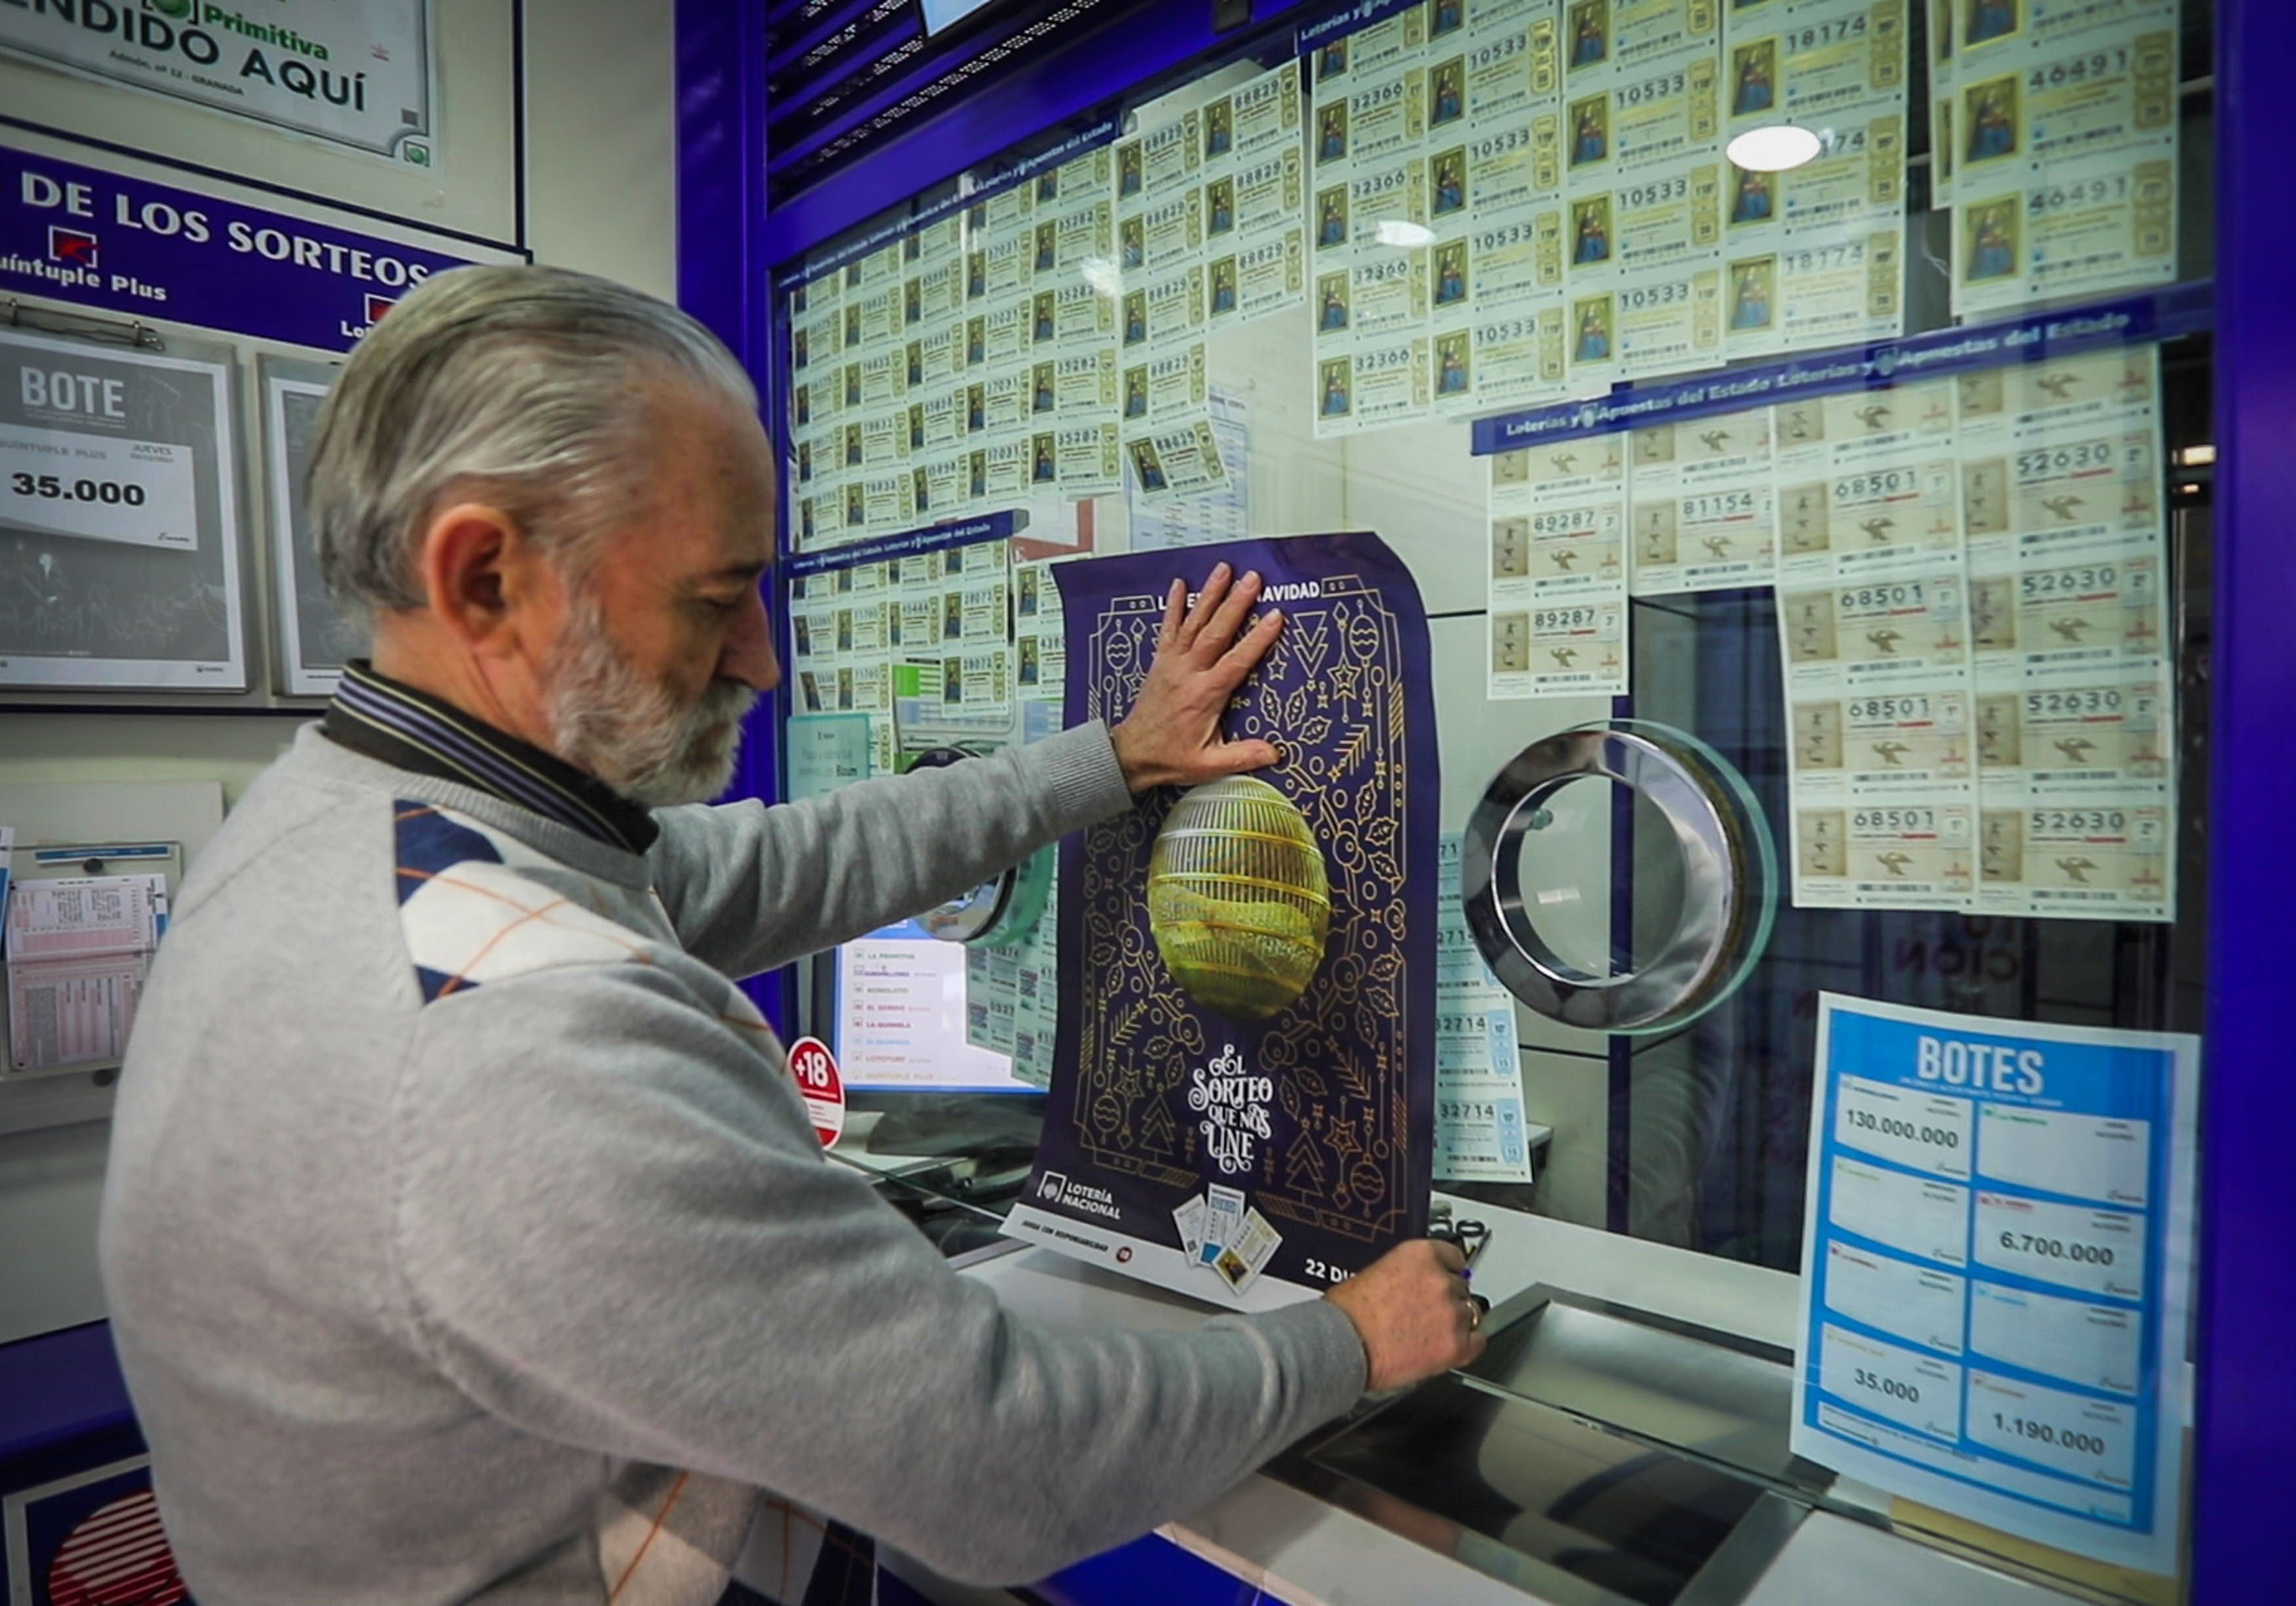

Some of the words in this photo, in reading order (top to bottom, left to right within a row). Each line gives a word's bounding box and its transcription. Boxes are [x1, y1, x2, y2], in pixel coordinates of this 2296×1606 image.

[204, 4, 329, 61] Primitiva
[1787, 15, 1866, 53] 18174
[0, 0, 219, 64] NDIDO
[240, 48, 365, 112] AQUÍ
[1471, 34, 1527, 70] 10533
[2029, 50, 2128, 89] 46491
[1616, 74, 1685, 108] 10533
[1473, 131, 1530, 160] 10533
[1620, 179, 1687, 209] 10533
[2028, 176, 2128, 213] 46491
[21, 171, 94, 218] DE
[116, 194, 209, 243] LOS
[228, 221, 431, 290] SORTEOS
[1475, 224, 1532, 253] 10533
[1786, 244, 1863, 272] 18174
[111, 274, 167, 301] Plus
[1621, 283, 1689, 312] 10533
[1477, 319, 1536, 344] 10533
[1507, 414, 1567, 436] Loterías
[1597, 395, 1673, 422] Apuestas
[1677, 388, 1704, 405] del
[1708, 377, 1771, 400] Estado
[1778, 362, 1855, 388] Loterías
[1896, 336, 1998, 368] Apuestas
[2005, 327, 2040, 348] del
[2046, 312, 2130, 339] Estado
[20, 365, 125, 418] BOTE
[2018, 444, 2110, 476] 52630
[12, 472, 146, 506] 35.000
[1836, 470, 1916, 497] 68501
[1684, 493, 1753, 515] 81154
[1534, 510, 1595, 531] 89287
[1841, 585, 1923, 608] 68501
[2022, 569, 2116, 594] 52630
[1534, 609, 1595, 628] 89287
[1849, 698, 1930, 717] 68501
[2027, 690, 2121, 711] 52630
[1853, 810, 1934, 827] 68501
[2032, 812, 2125, 830] 52630
[794, 1050, 829, 1088] +18
[1208, 1043, 1246, 1077] EL
[1917, 1035, 2045, 1096] BOTES
[1188, 1068, 1274, 1111] SORTEO
[1208, 1104, 1237, 1128] QUE
[1239, 1103, 1272, 1140] NOS
[1441, 1104, 1494, 1118] 32714
[1846, 1107, 1959, 1149] 130.000.000
[1199, 1120, 1255, 1174] UNE
[1061, 1194, 1121, 1220] NACIONAL
[1067, 1182, 1113, 1204] LOTERÍA
[2000, 1231, 2115, 1266] 6.700.000
[1304, 1258, 1326, 1279] 22
[1854, 1367, 1920, 1404] 35.000
[1992, 1412, 2105, 1456] 1.190.000
